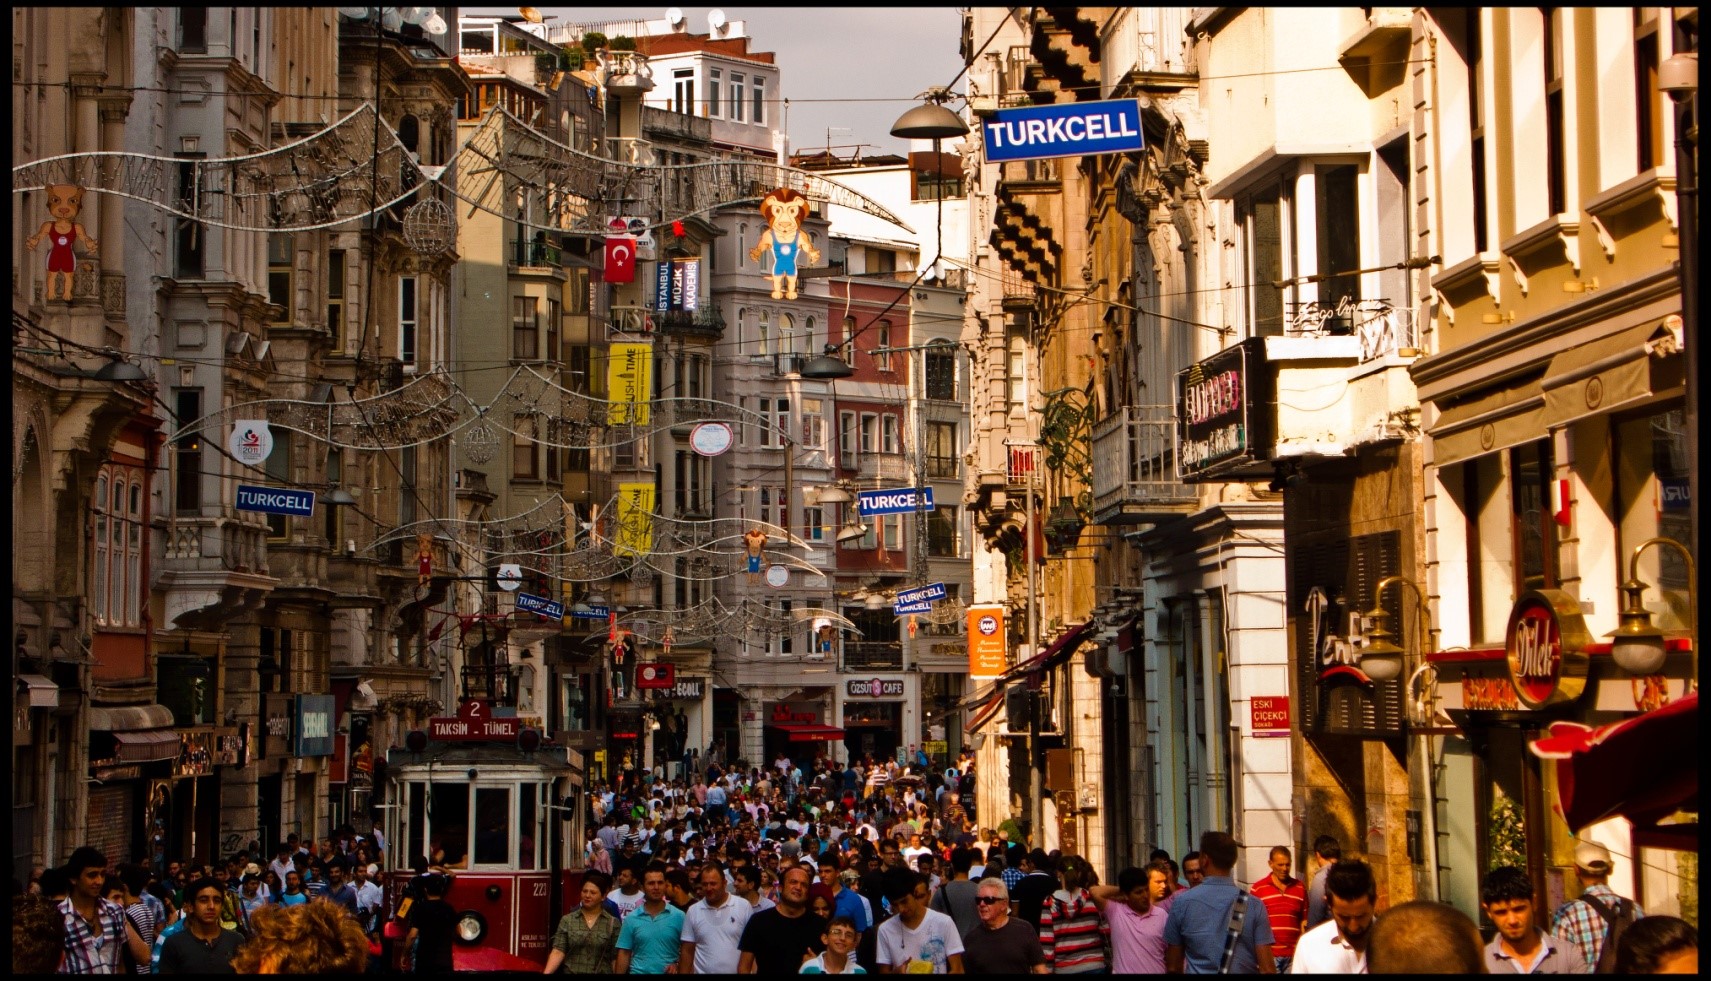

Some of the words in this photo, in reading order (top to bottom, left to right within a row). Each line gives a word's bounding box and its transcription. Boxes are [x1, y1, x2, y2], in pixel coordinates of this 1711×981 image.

[988, 112, 1138, 148] TURKCELL
[672, 268, 683, 305] MÜZİK
[625, 348, 636, 371] TIME
[239, 491, 310, 510] TURKCELL
[860, 493, 932, 510] TURKCEL
[1515, 618, 1554, 677] Dilek
[851, 681, 872, 694] ÖZSÜT
[883, 683, 902, 694] CAFE
[470, 702, 480, 717] 2
[1253, 699, 1273, 709] ESKİ
[1254, 710, 1287, 721] ÇİÇEKÇİ
[434, 720, 468, 736] TAKSİM
[483, 722, 515, 736] TÜNEL
[533, 882, 547, 897] 223
